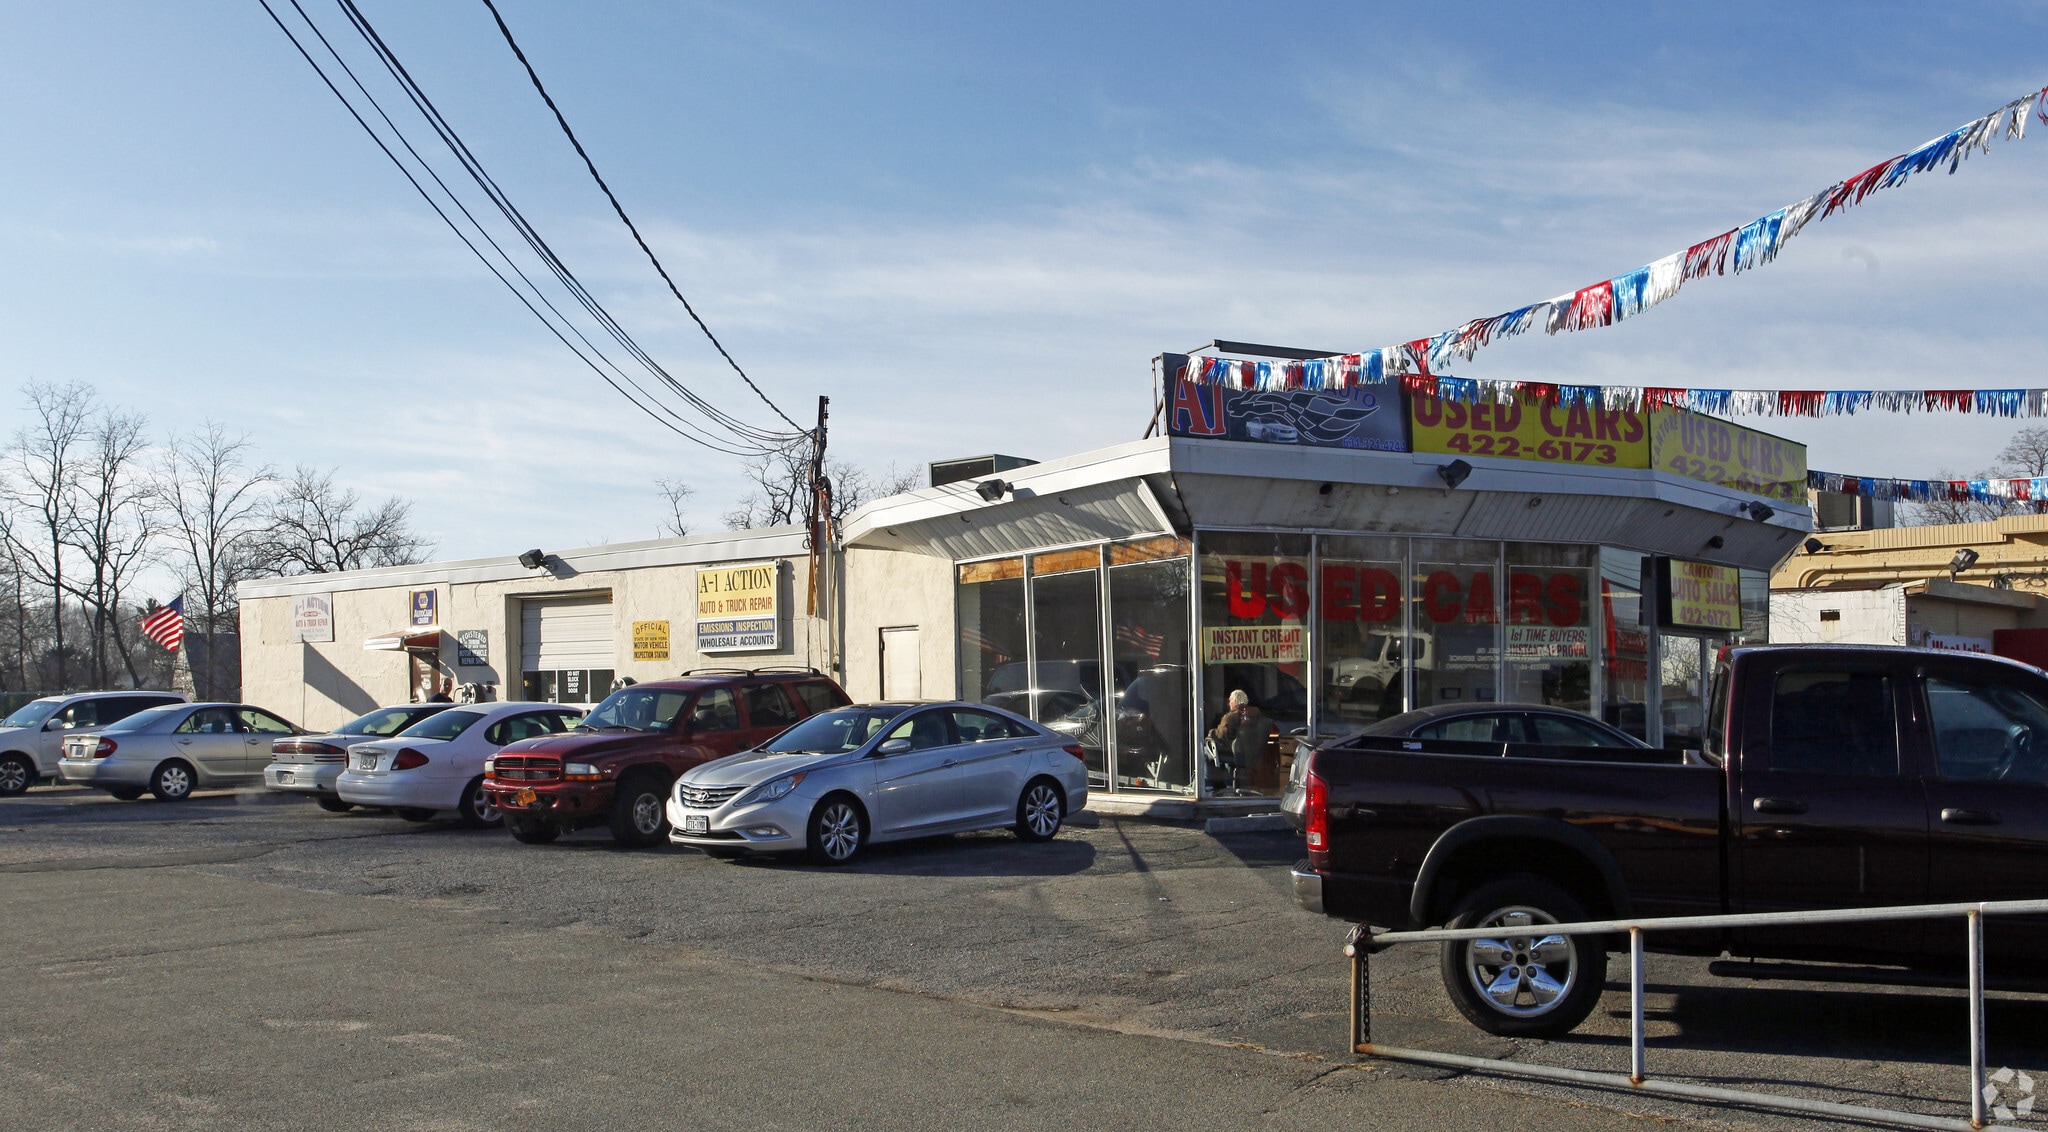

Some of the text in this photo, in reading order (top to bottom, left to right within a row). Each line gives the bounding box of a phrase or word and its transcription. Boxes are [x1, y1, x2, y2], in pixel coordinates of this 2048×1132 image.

[1323, 386, 1376, 407] AUTO
[1414, 388, 1644, 443] USED CARS
[1446, 433, 1617, 464] 422-6173
[1681, 413, 1732, 463] USED
[1737, 431, 1784, 477] CARS
[700, 568, 772, 593] A-1 ACTION
[1682, 562, 1725, 581] CANTORE
[1225, 560, 1582, 627] USED CARS
[1672, 576, 1738, 606] AUTO SALES
[700, 596, 773, 614] AUTO & TRUCK REPAIR
[1680, 606, 1731, 627] 422-6173
[635, 622, 667, 635] OFFICIAL
[700, 620, 773, 634] EMISSIONS INSPECTION
[1212, 628, 1301, 644] INSTANT CREDIT
[1526, 629, 1547, 642] TIME
[1549, 629, 1588, 643] BUYERS:
[459, 630, 487, 644] REGISTERED
[649, 641, 668, 649] VEHICLE
[700, 635, 775, 648] WHOLESALE ACCOUNTS
[1210, 644, 1304, 661] APPROVAL HERE!
